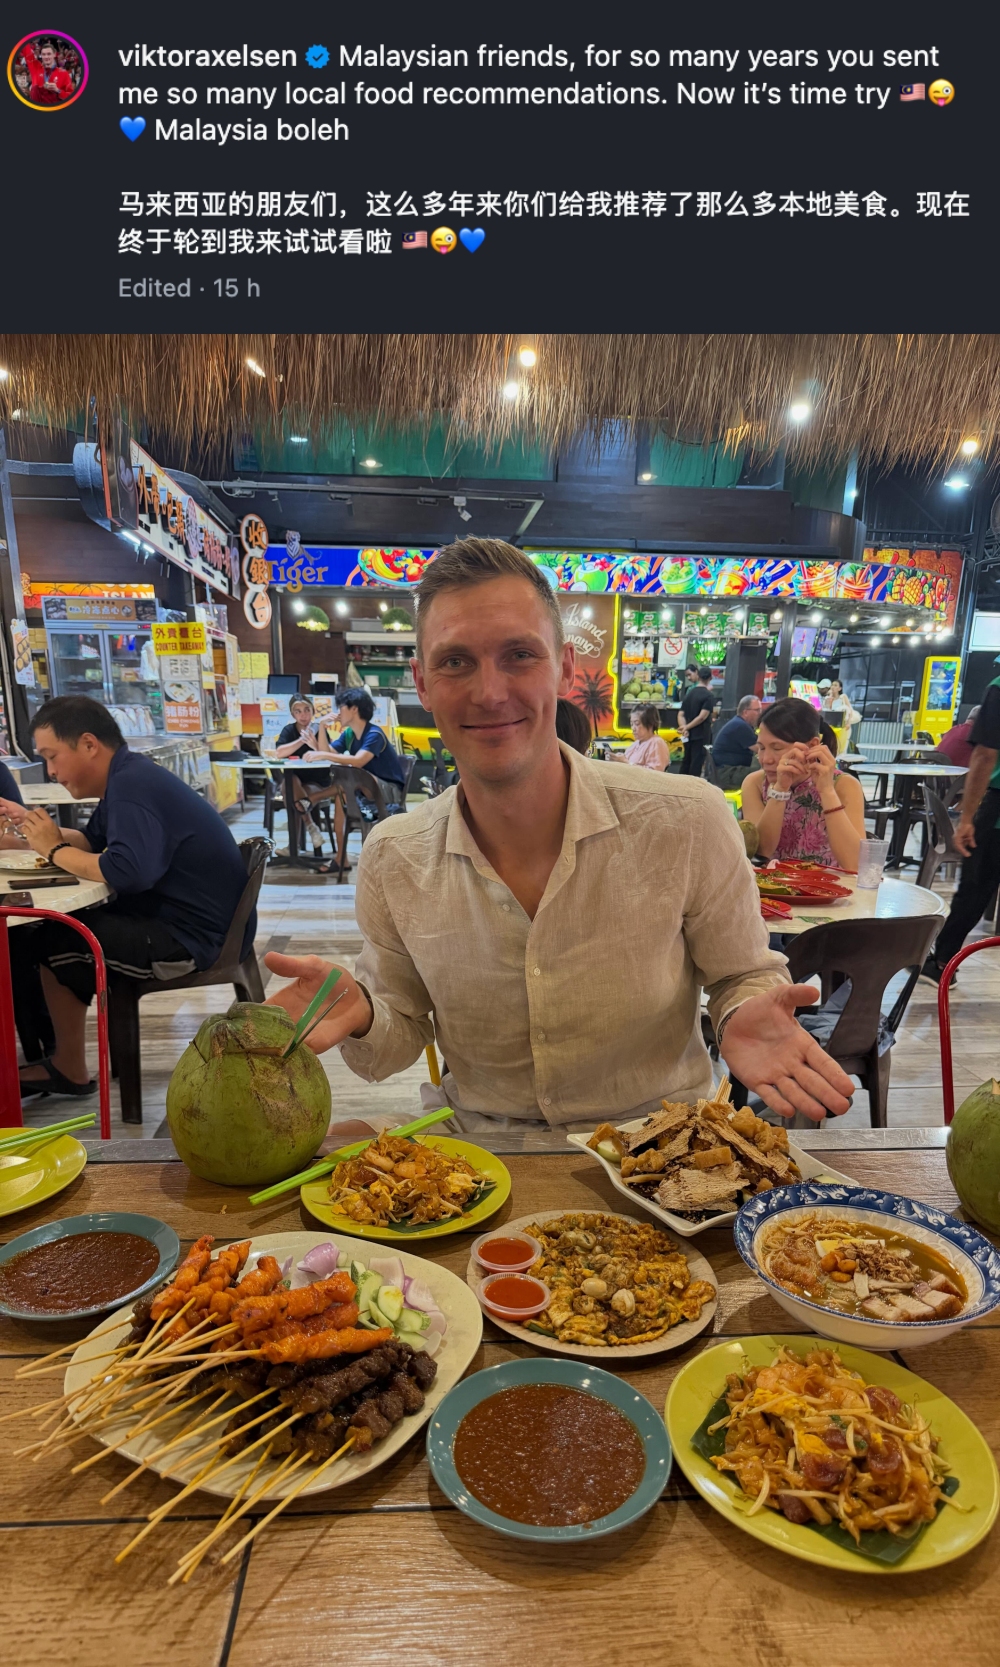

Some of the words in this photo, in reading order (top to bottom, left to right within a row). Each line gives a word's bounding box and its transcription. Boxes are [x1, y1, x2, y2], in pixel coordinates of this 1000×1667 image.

[267, 558, 328, 593] Tiger
[563, 602, 607, 645] Island
[155, 642, 178, 652] COUNTER
[179, 641, 205, 651] TAKEAWAY
